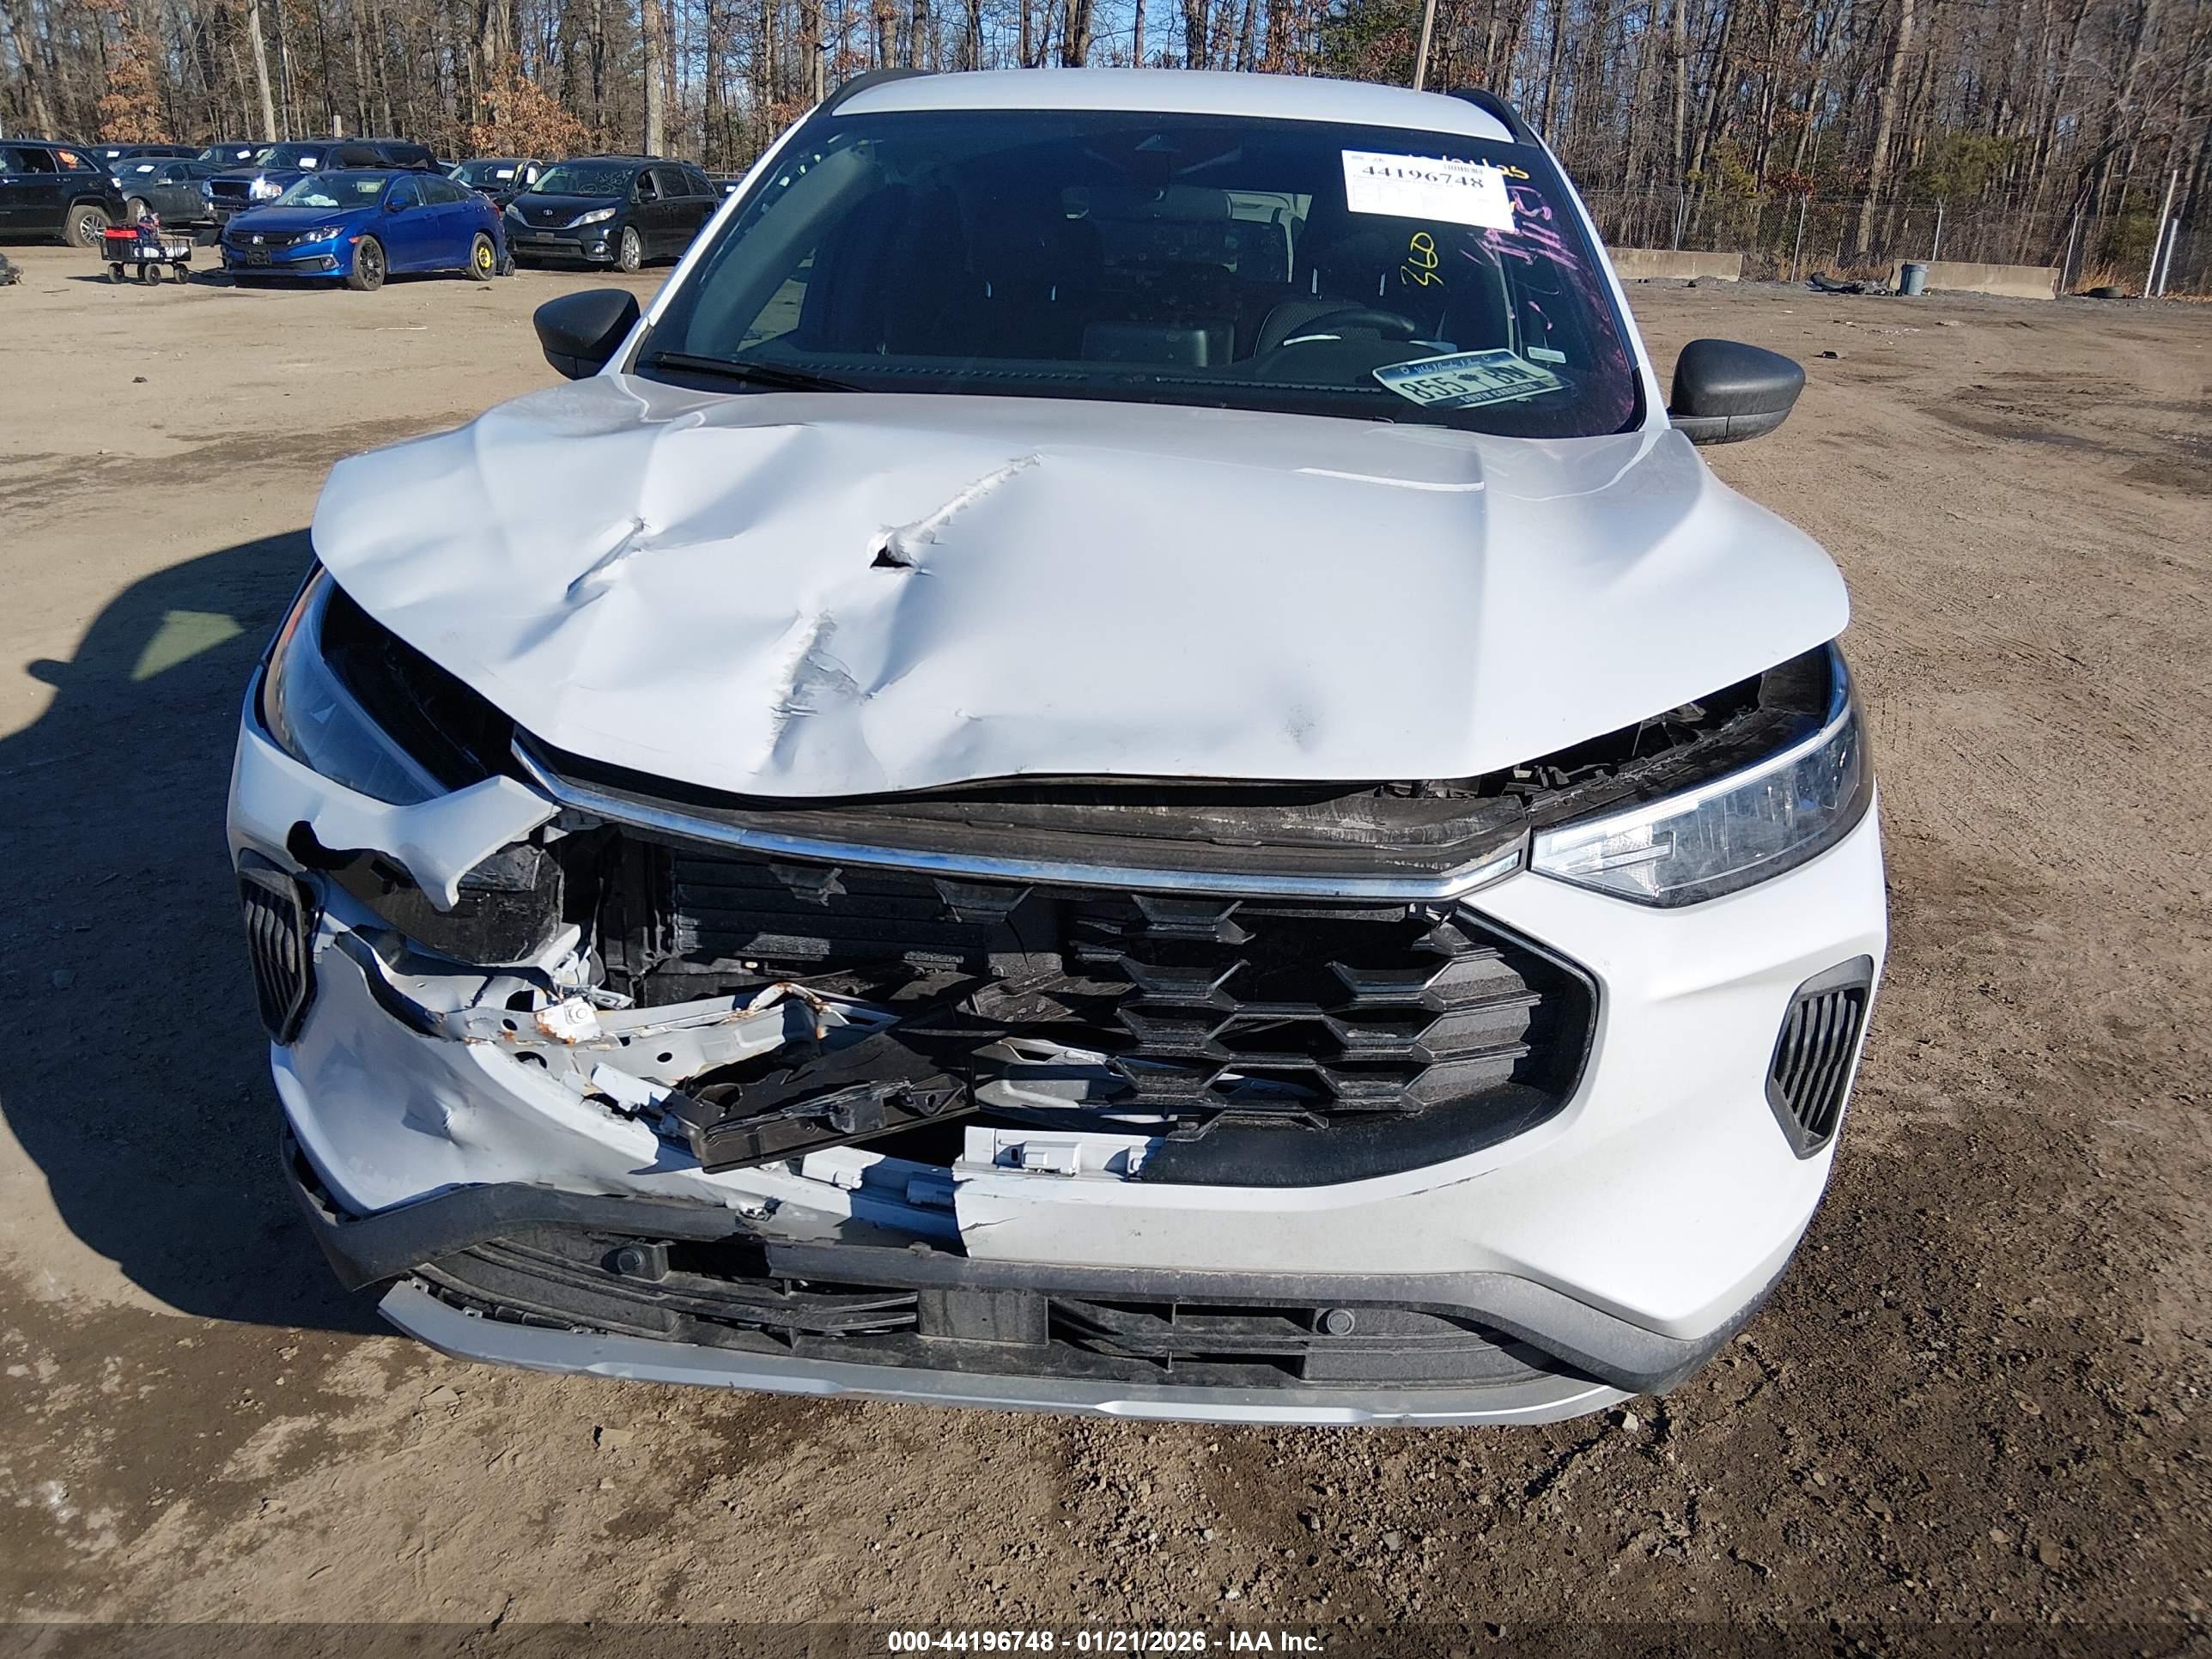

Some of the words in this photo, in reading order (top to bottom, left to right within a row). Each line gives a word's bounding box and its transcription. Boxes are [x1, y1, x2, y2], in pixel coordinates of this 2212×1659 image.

[1362, 166, 1485, 188] 44196748
[1399, 377, 1469, 400] 855
[1459, 392, 1494, 403] SOUTH
[1491, 383, 1540, 397] CAROLINA
